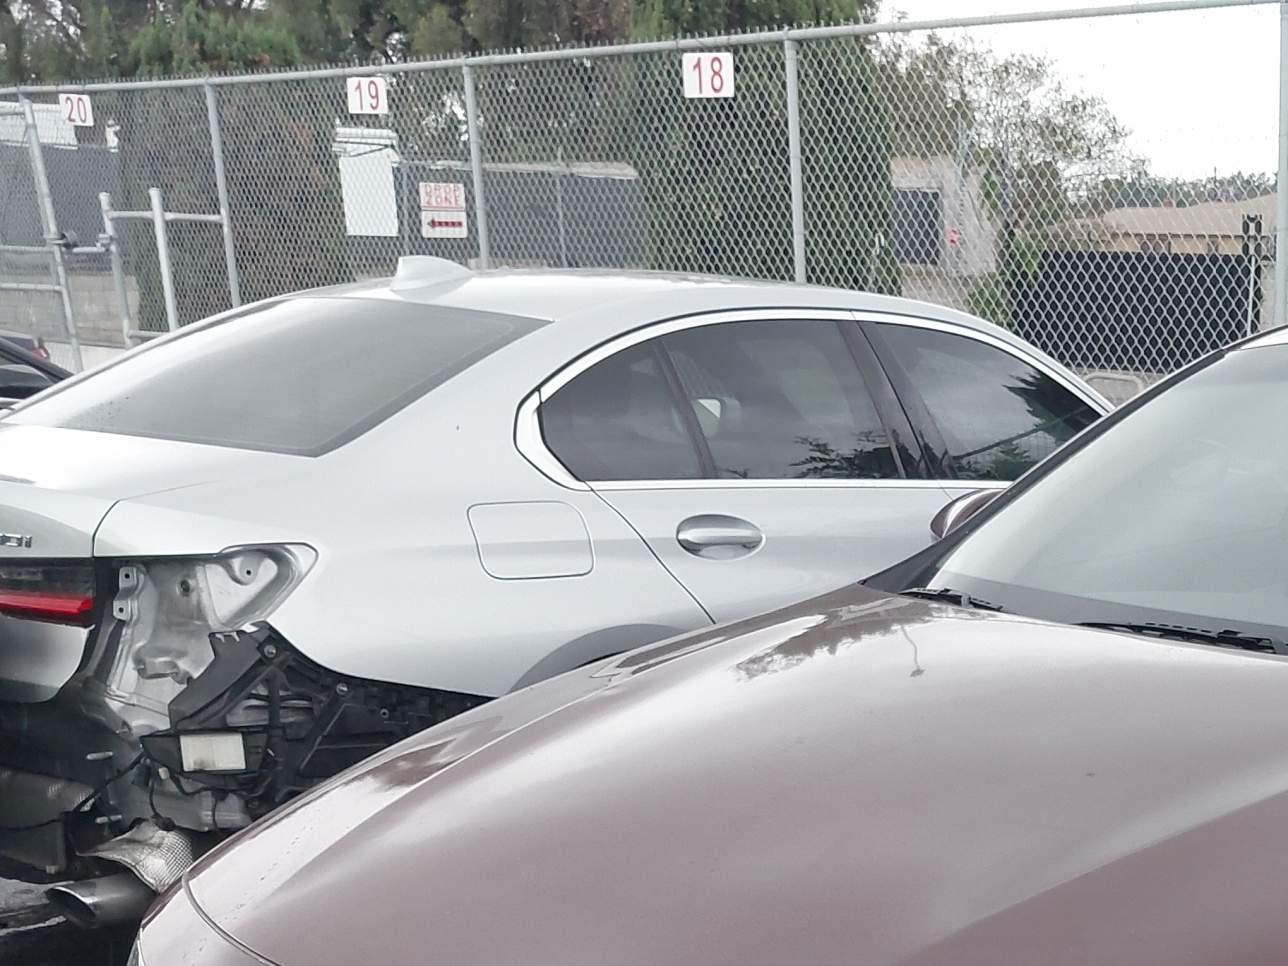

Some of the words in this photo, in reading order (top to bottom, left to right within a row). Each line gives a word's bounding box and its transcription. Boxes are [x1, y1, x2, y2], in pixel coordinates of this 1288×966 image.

[693, 57, 723, 94] 18
[65, 96, 87, 123] 20
[354, 80, 379, 111] 19
